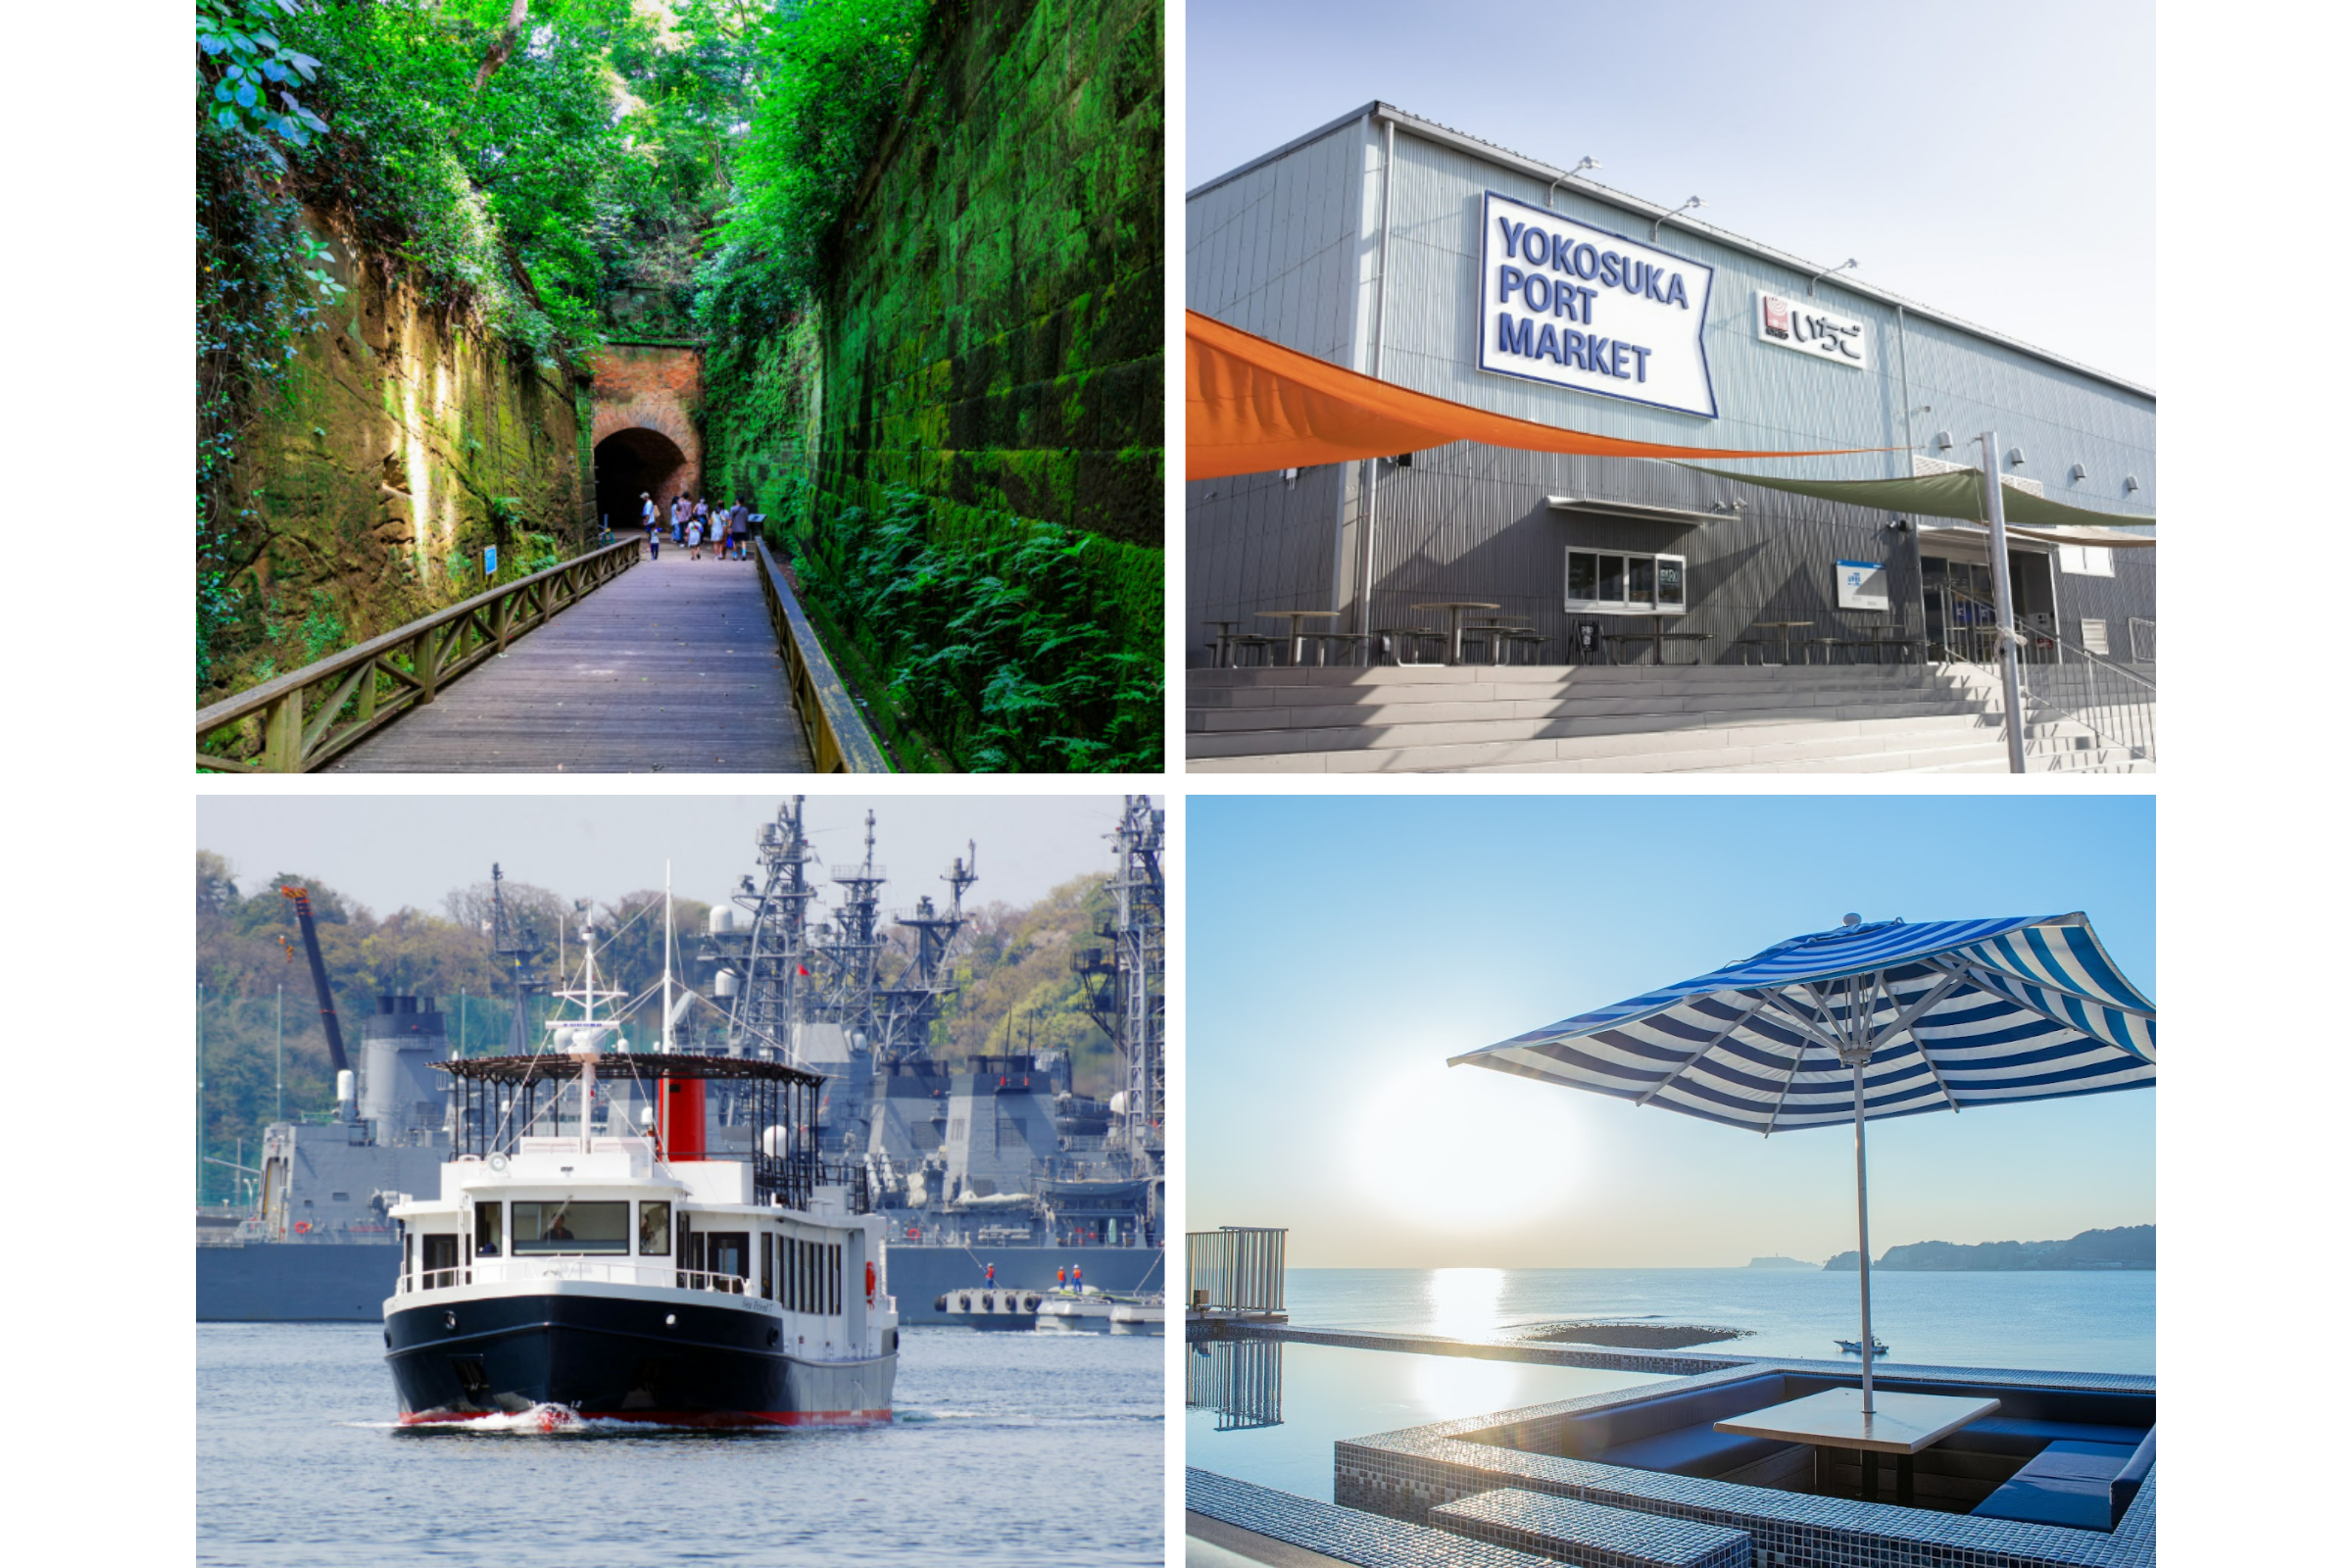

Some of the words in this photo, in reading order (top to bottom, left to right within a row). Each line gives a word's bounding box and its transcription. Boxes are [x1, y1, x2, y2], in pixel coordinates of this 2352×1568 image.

[1499, 216, 1690, 310] YOKOSUKA
[1500, 264, 1598, 325] PORT
[1499, 312, 1652, 383] MARKET
[1791, 311, 1861, 360] いちご
